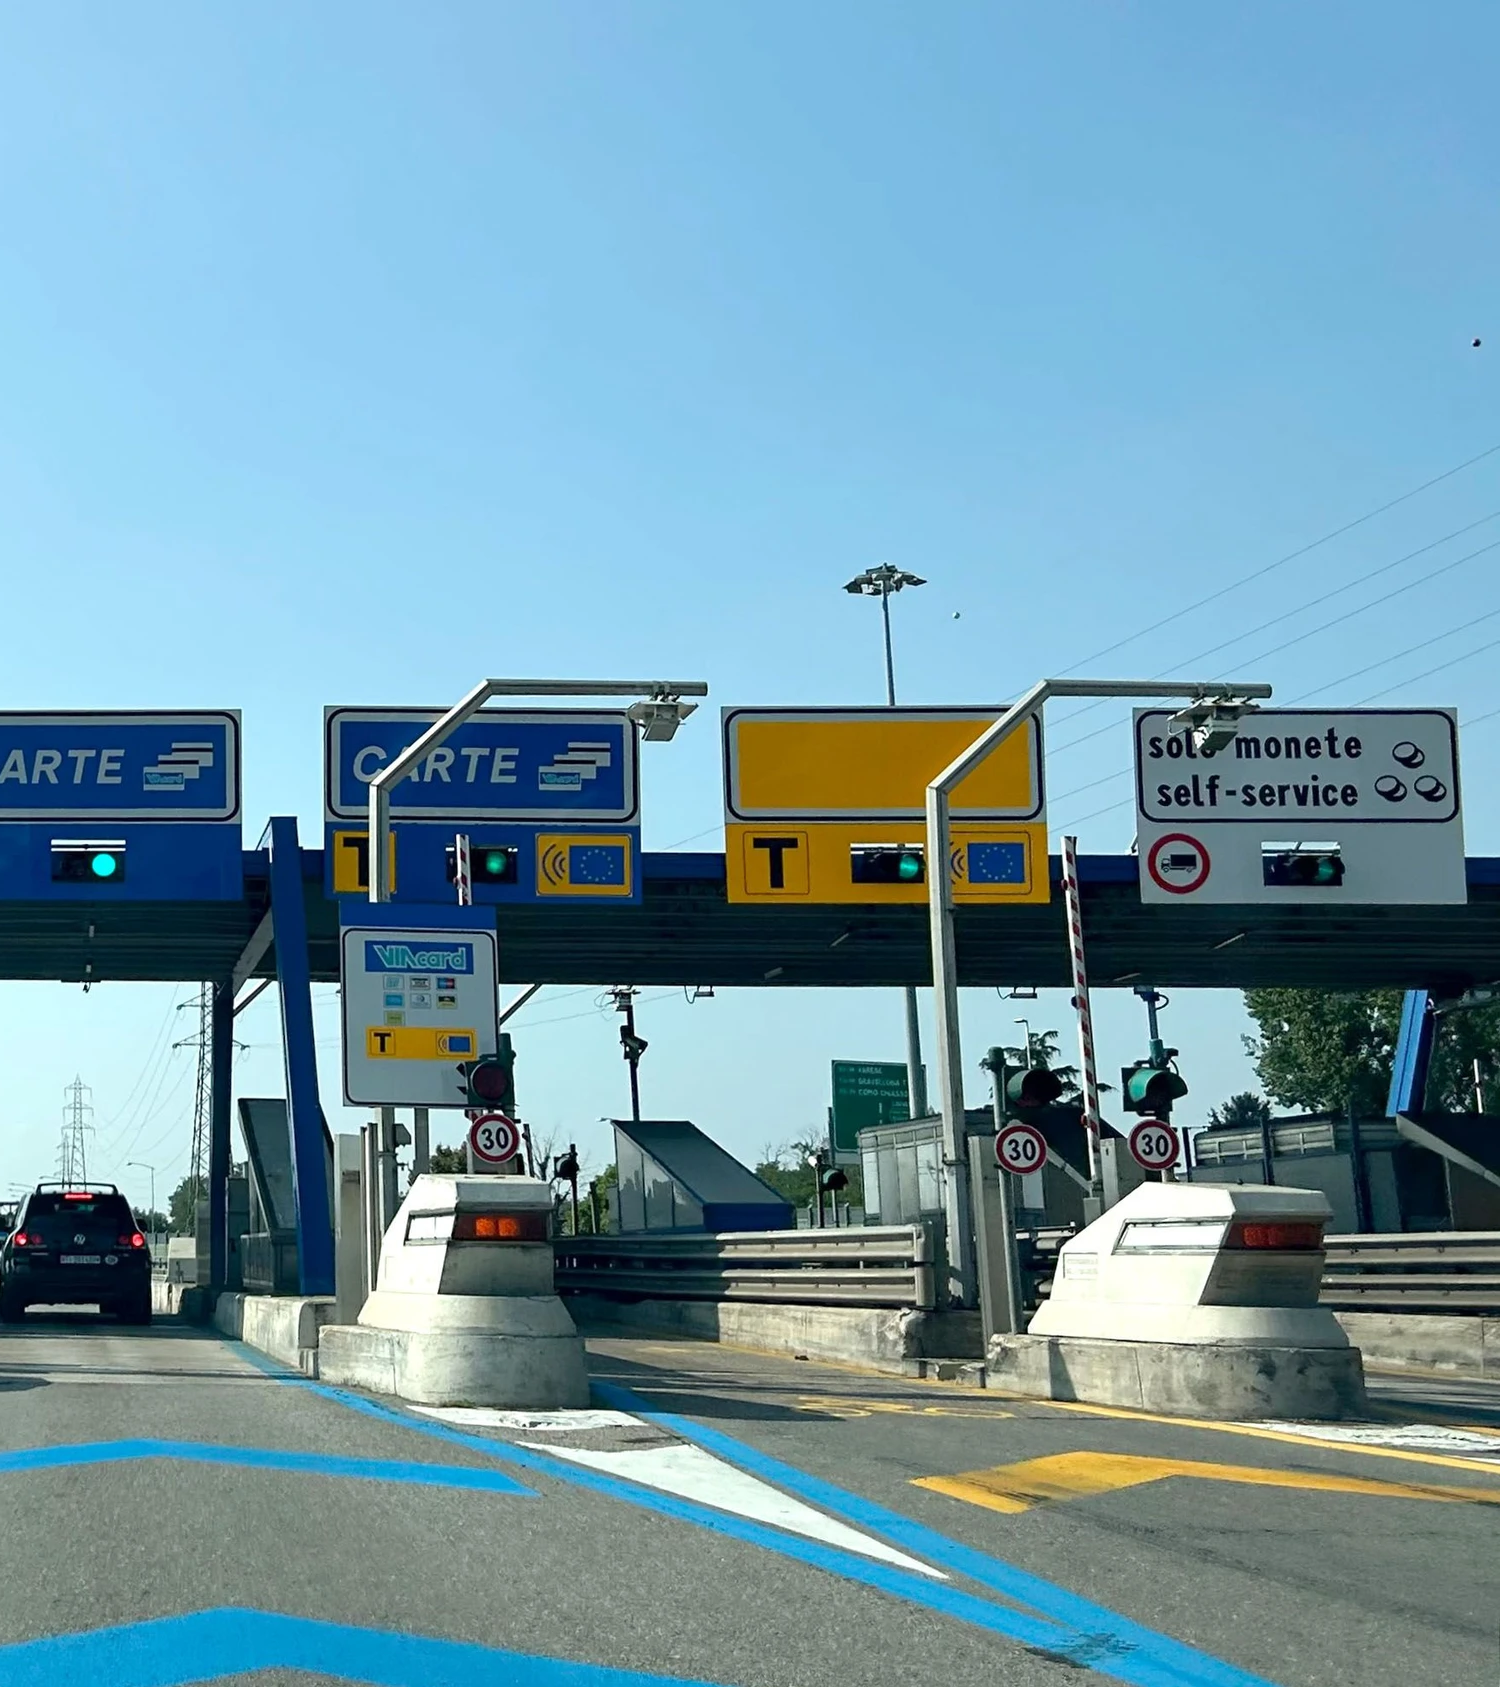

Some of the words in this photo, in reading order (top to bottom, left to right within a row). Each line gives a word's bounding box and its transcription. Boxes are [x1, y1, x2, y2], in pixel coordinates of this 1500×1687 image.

[1235, 727, 1362, 759] monete
[1157, 774, 1358, 806] self-service
[342, 837, 370, 886] T
[753, 837, 799, 888] T
[373, 945, 466, 970] VIAcard
[374, 1032, 391, 1052] T
[481, 1127, 510, 1150] 30
[1007, 1139, 1037, 1161] 30
[1141, 1133, 1169, 1155] 30
